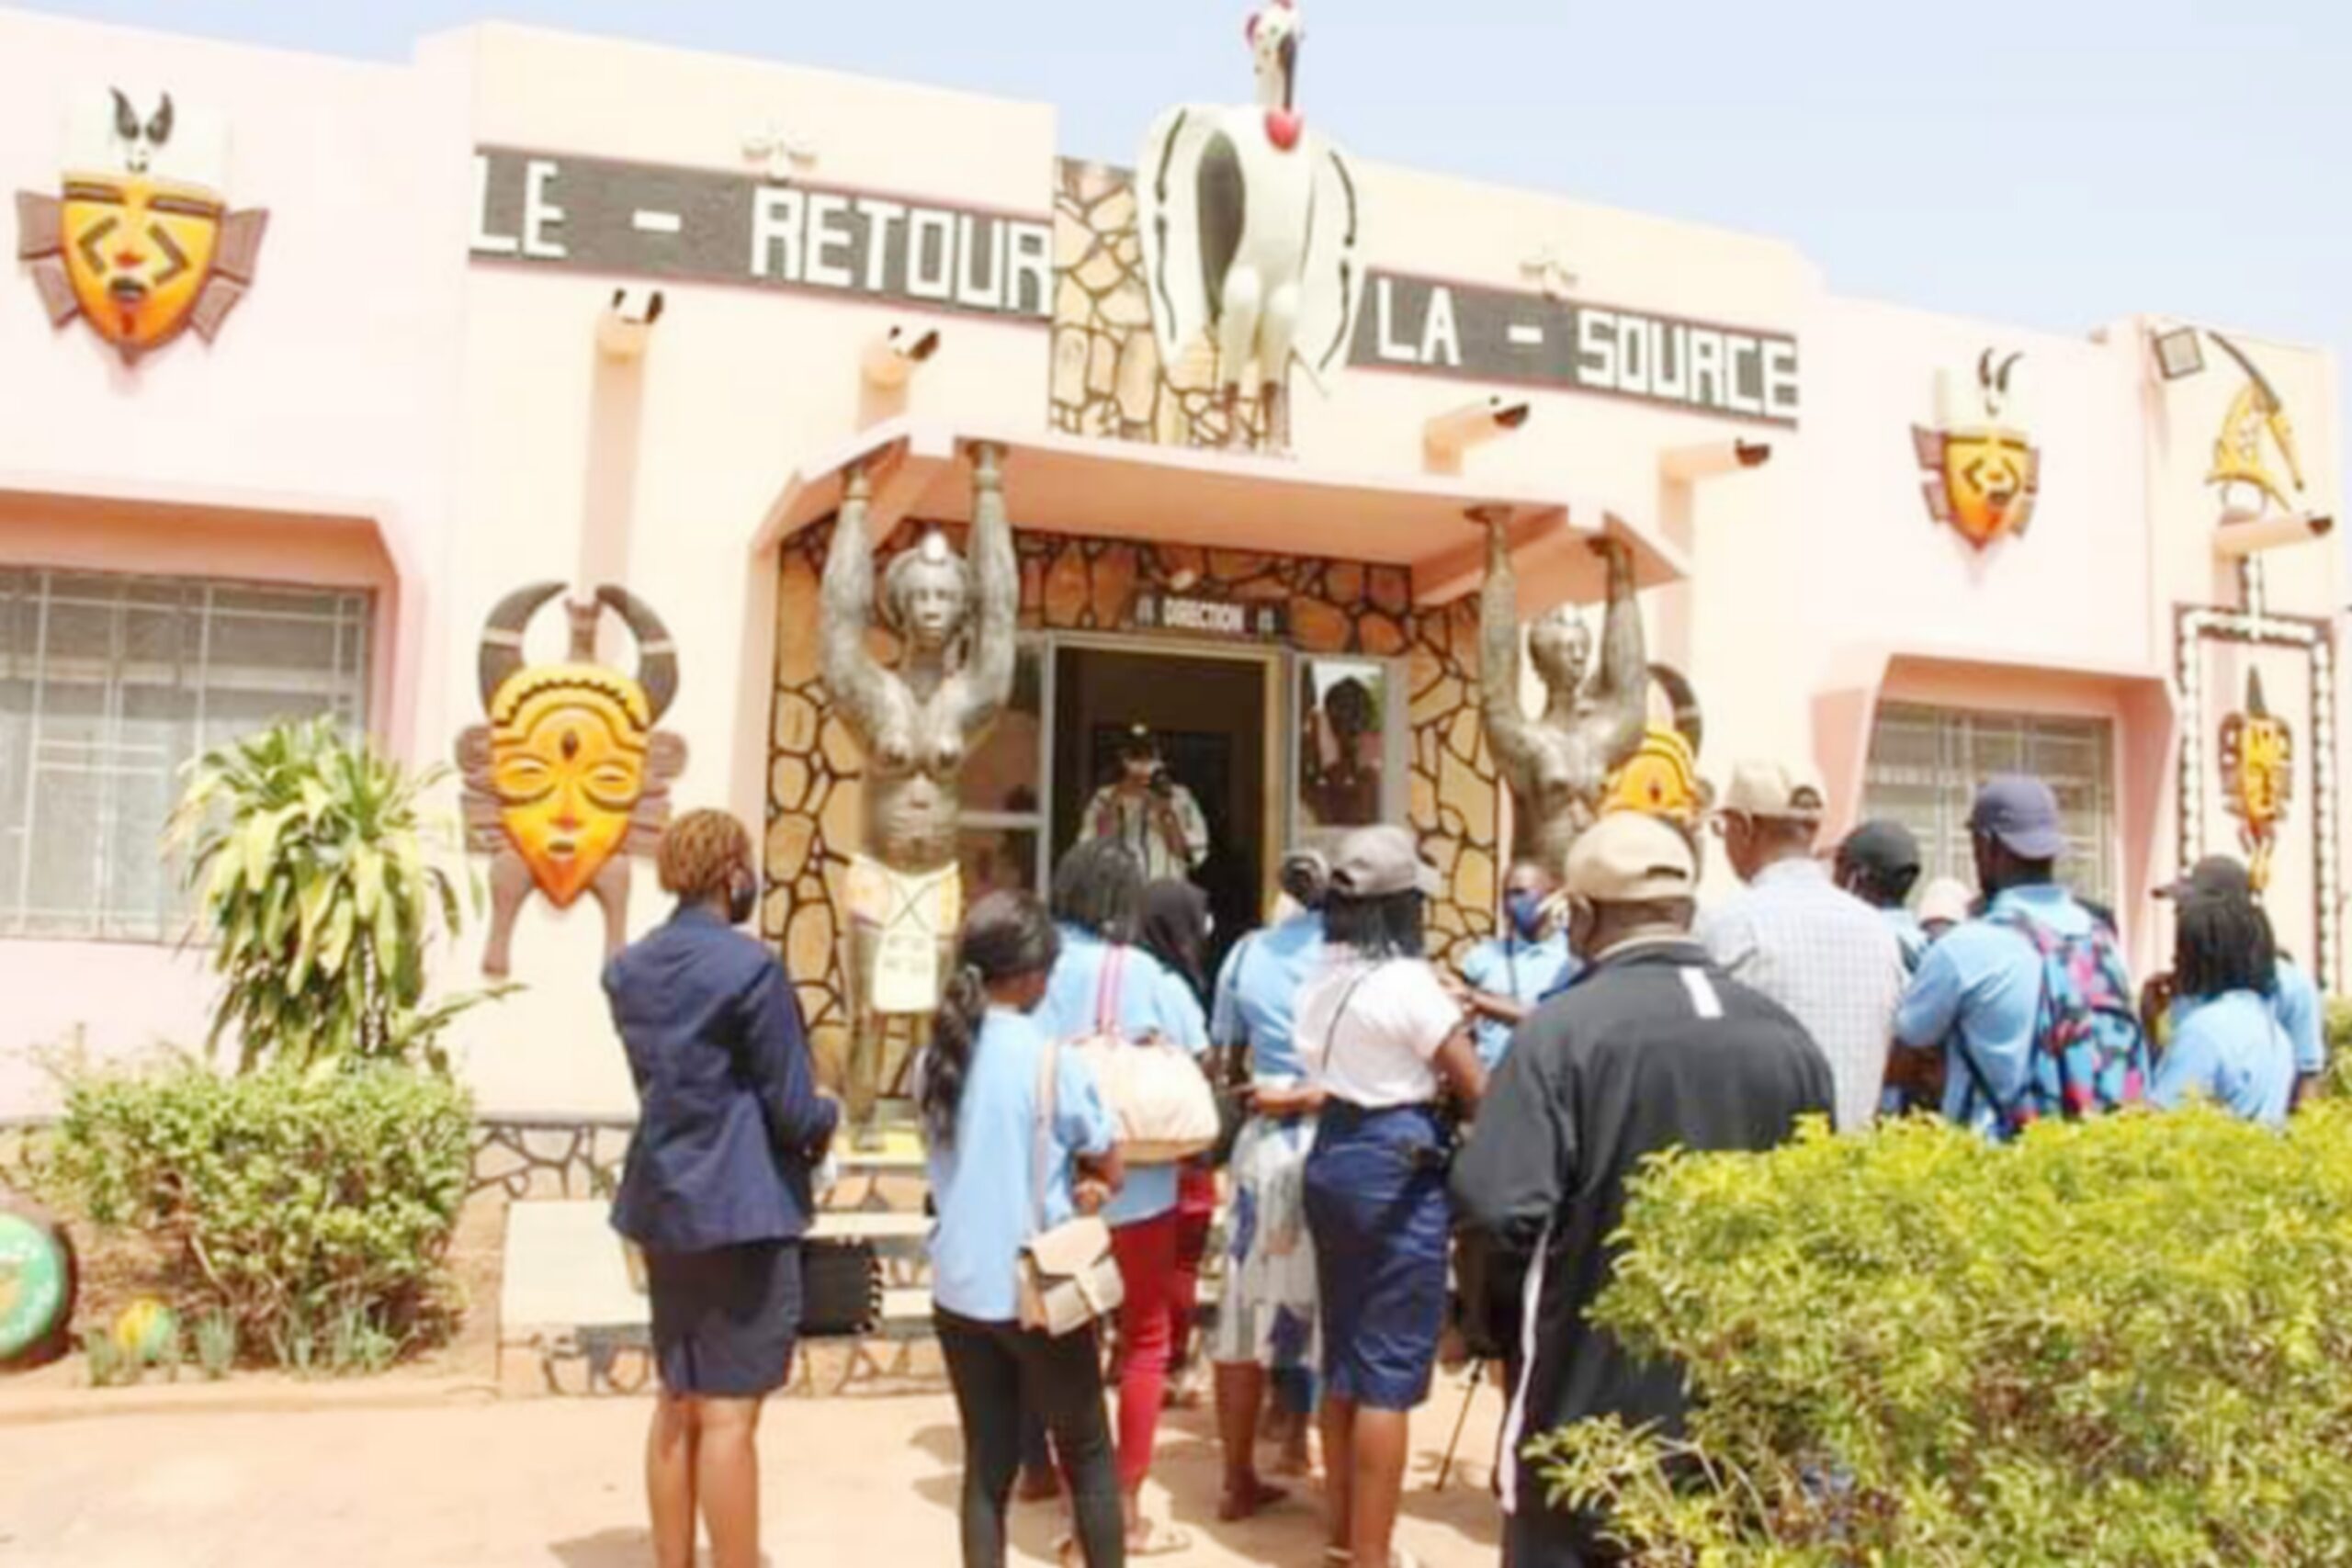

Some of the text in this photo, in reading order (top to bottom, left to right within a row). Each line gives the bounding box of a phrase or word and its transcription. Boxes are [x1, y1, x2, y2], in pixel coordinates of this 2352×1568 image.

[469, 154, 1053, 317] LE - RETOUR
[1378, 279, 1798, 420] LA - SOURCE
